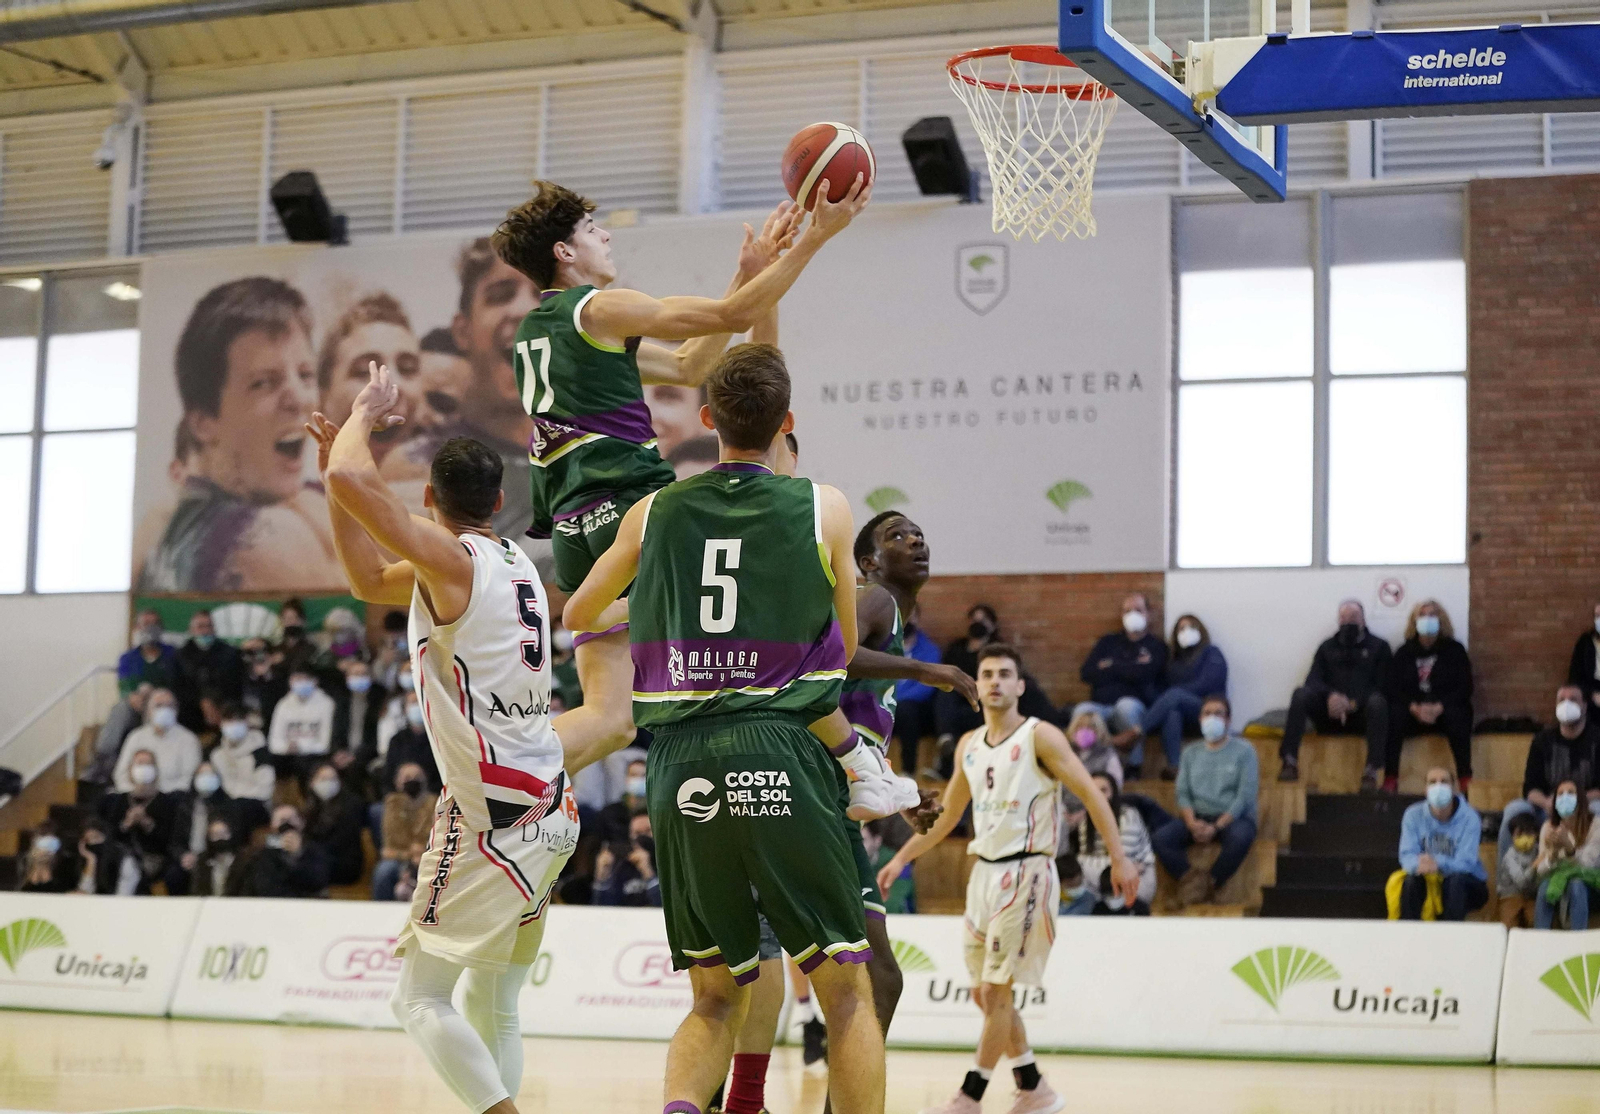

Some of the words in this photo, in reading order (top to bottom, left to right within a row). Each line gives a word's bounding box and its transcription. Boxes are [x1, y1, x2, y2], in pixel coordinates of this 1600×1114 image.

[1407, 47, 1507, 70] schelde
[1404, 72, 1503, 88] international
[820, 378, 970, 403] NUESTRA
[990, 371, 1144, 398] CANTERA
[863, 411, 981, 430] NUESTRO
[996, 405, 1098, 426] FUTURO
[582, 511, 594, 525] EL
[594, 501, 617, 517] SOL
[700, 538, 742, 634] 5
[511, 579, 545, 672] 5
[688, 647, 758, 667] MÁLAGA
[725, 771, 791, 787] COSTA
[726, 790, 757, 803] DEL
[760, 788, 792, 802] SOL
[729, 802, 792, 817] MÁLAGA
[54, 953, 149, 985] Unicaja
[1333, 986, 1460, 1022] Unicaja
